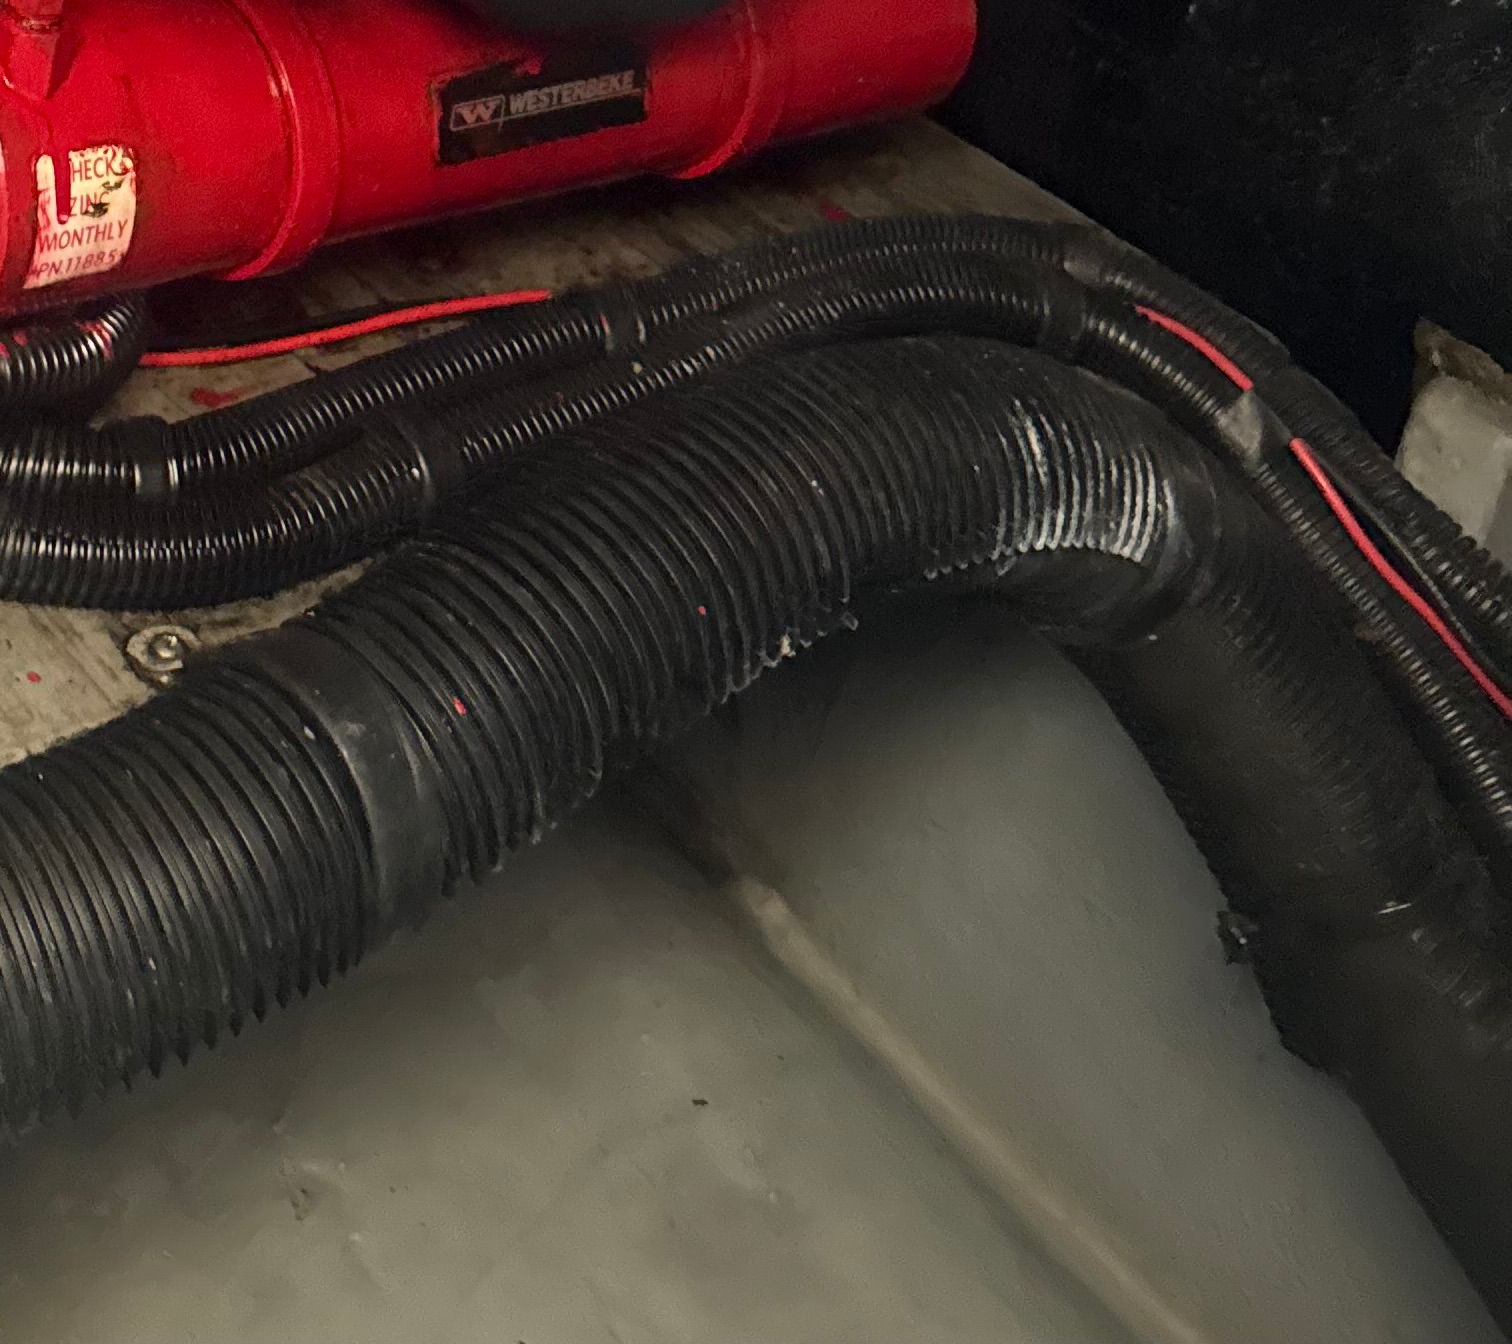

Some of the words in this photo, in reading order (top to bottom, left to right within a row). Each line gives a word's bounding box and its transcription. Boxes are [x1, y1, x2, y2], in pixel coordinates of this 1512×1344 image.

[509, 69, 636, 114] WESTERBEKE
[71, 155, 118, 182] HECK
[38, 218, 129, 254] MONTHLY
